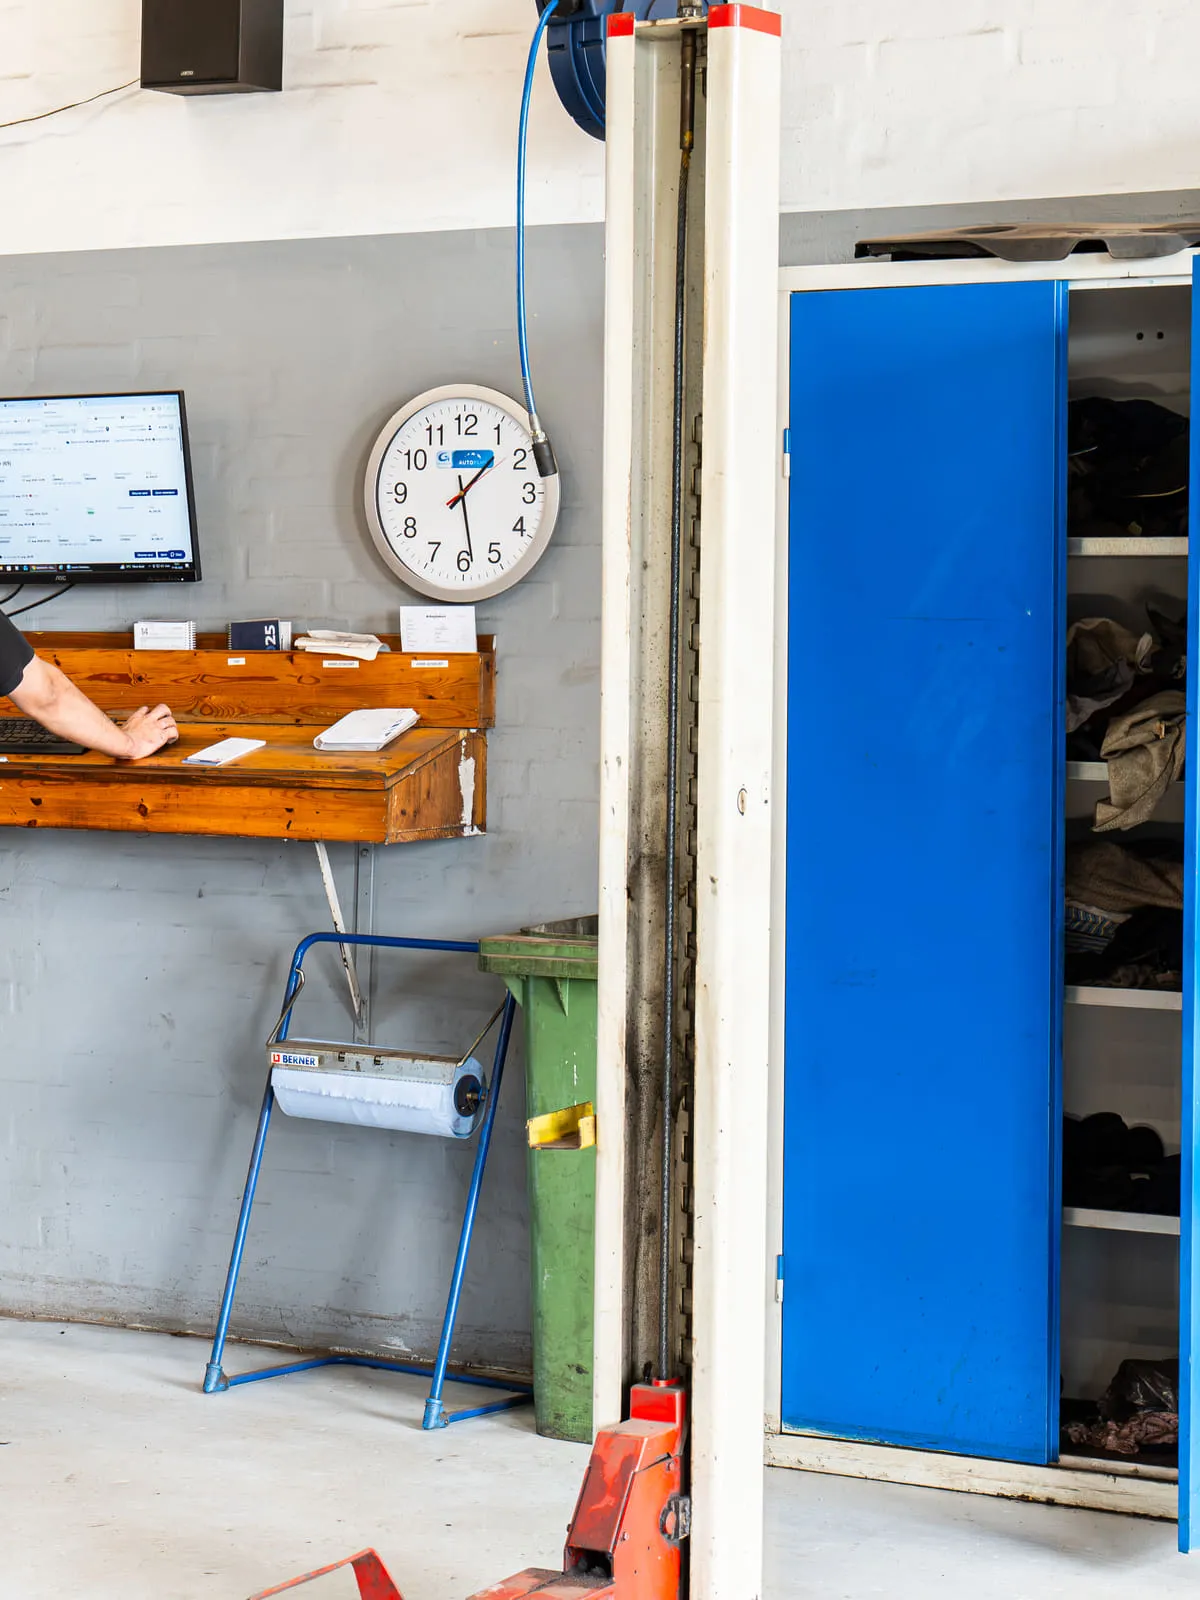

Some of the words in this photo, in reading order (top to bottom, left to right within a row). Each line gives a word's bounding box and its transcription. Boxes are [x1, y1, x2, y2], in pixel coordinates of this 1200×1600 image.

[426, 424, 444, 446] 11
[455, 414, 478, 436] 12
[494, 424, 501, 445] 1
[404, 449, 428, 471] 10
[513, 448, 527, 470] 2
[394, 482, 408, 504] 9
[522, 482, 536, 504] 3
[404, 516, 417, 538] 8
[512, 516, 526, 537] 4
[428, 542, 442, 562] 7
[457, 550, 470, 572] 6
[488, 542, 501, 564] 5
[282, 1054, 316, 1066] BERNER
